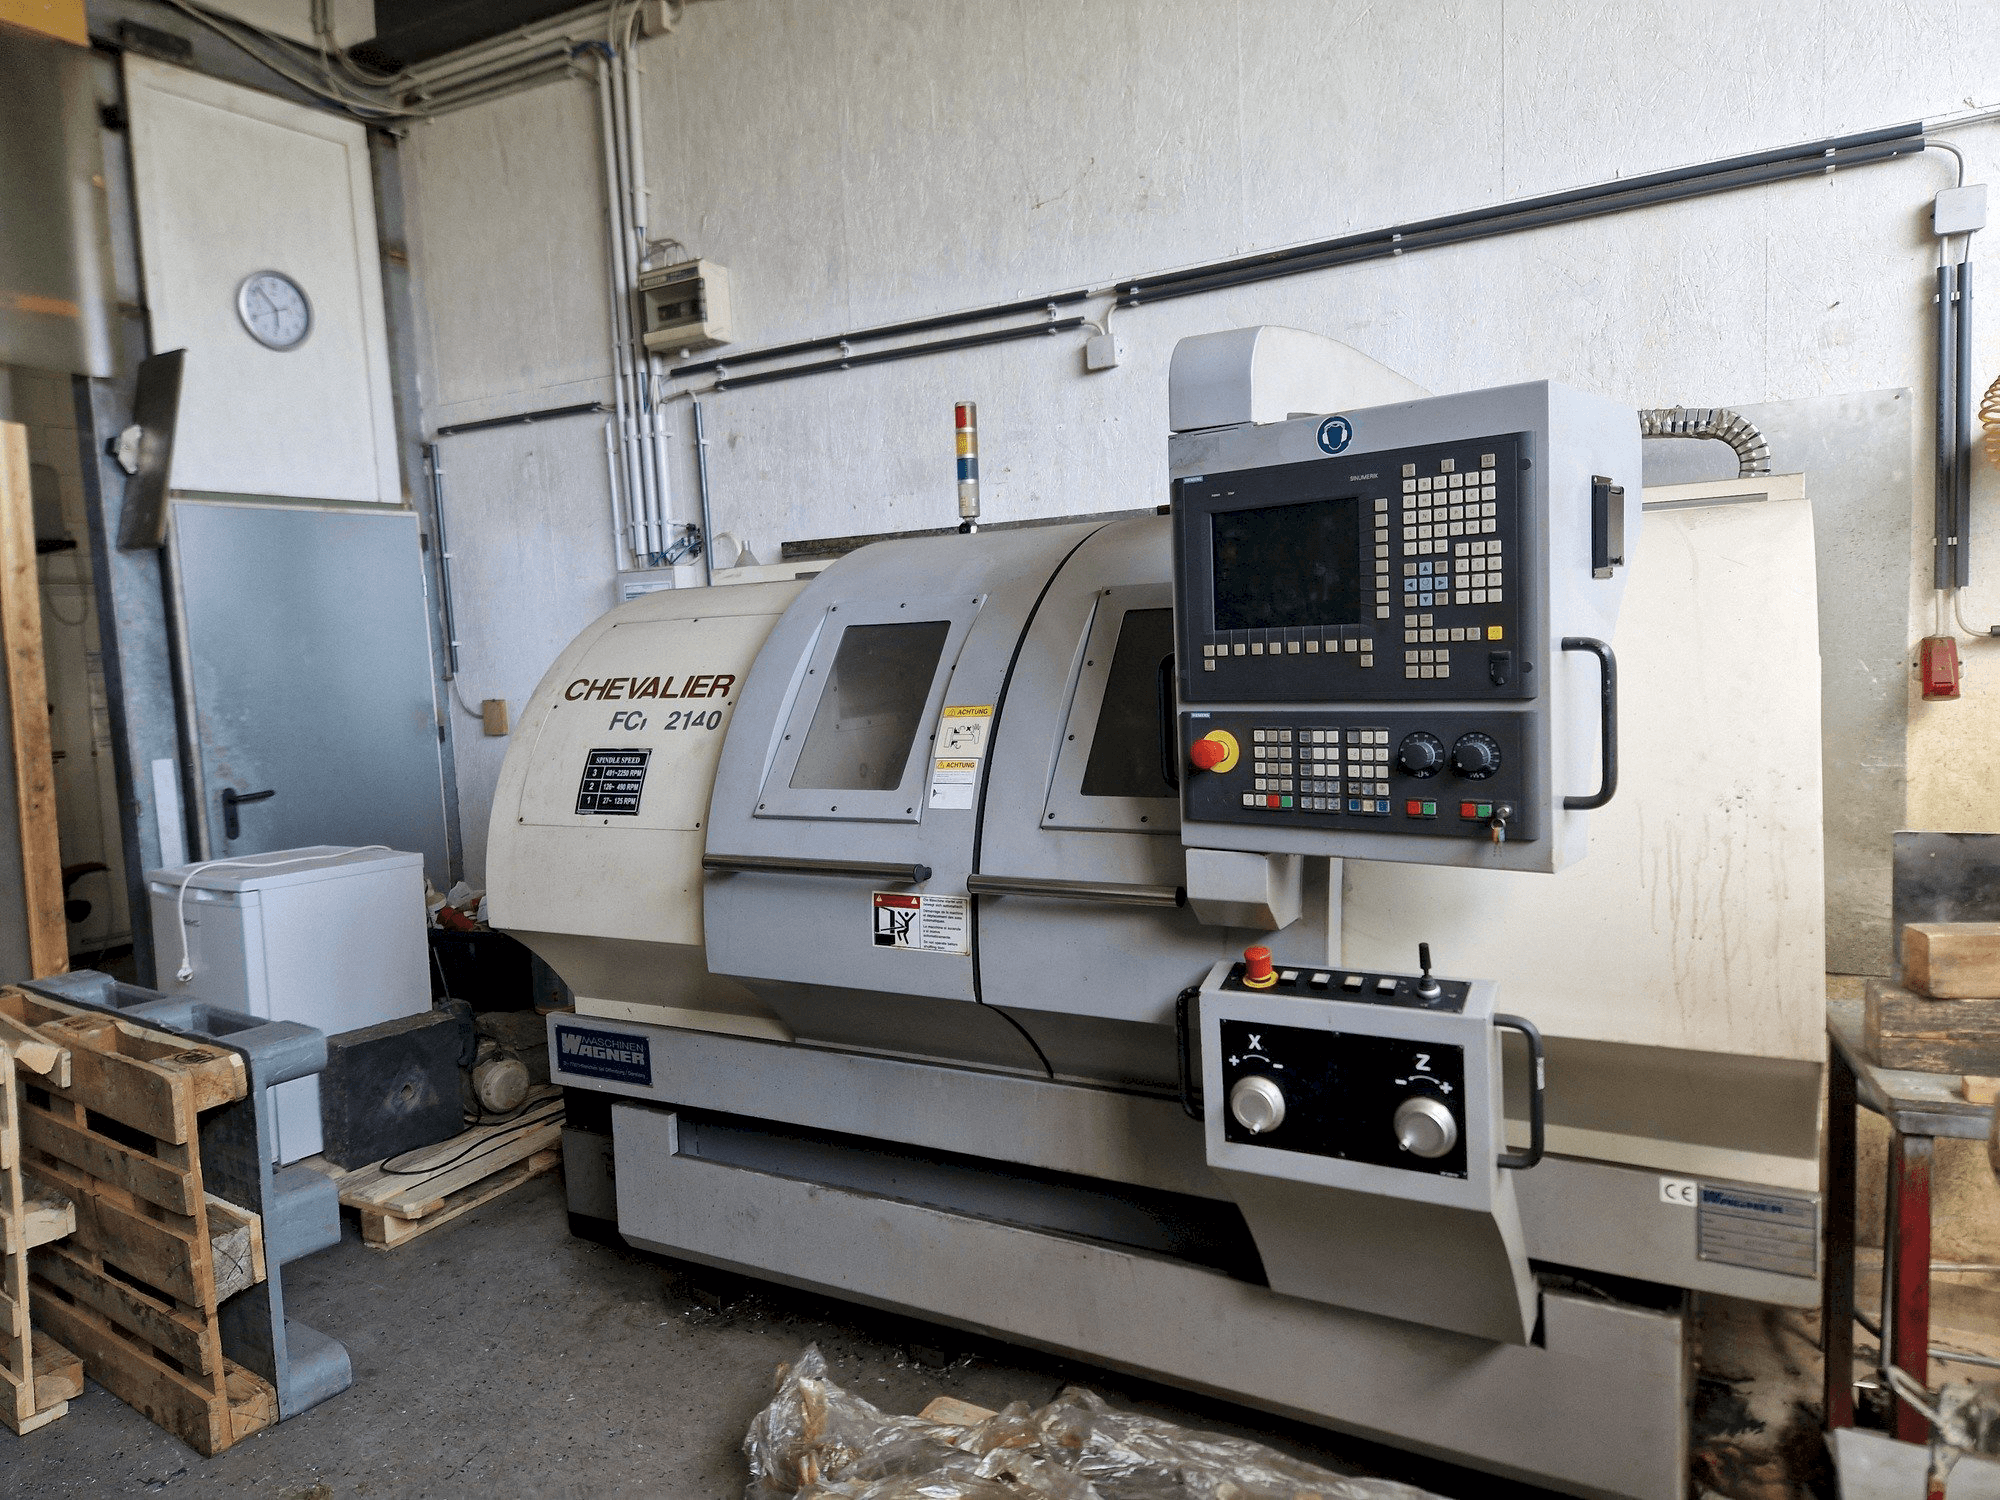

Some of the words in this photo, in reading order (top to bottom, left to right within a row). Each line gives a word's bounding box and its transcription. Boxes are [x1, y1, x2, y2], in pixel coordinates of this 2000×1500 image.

[1349, 473, 1379, 482] SINUMERIK
[564, 674, 735, 701] CHEVALIER
[664, 711, 722, 730] 2140
[561, 1033, 645, 1065] WAGNER
[582, 1036, 644, 1052] MASCHINEN
[1248, 1034, 1262, 1050] X
[1416, 1053, 1431, 1071] Z
